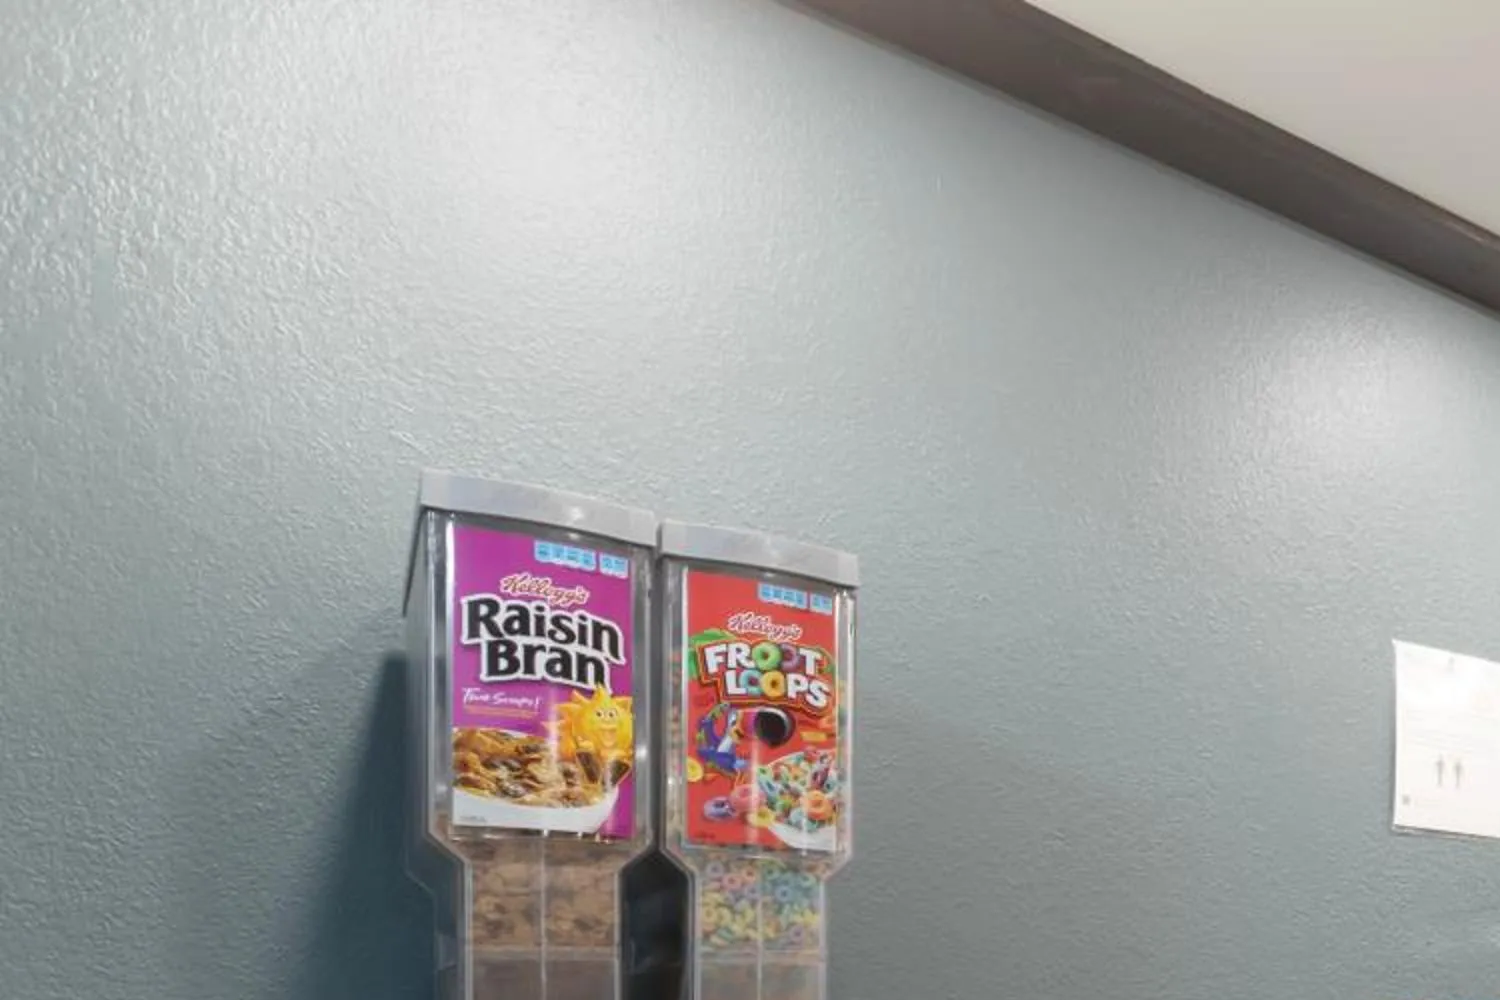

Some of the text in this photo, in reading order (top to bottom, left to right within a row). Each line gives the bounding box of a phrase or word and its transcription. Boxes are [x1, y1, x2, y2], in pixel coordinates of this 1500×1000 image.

[500, 572, 590, 607] Kellogg's
[464, 595, 625, 660] Raisin
[727, 611, 803, 641] Kellogg's
[484, 638, 608, 688] Bran
[704, 641, 822, 676] FROOT
[724, 668, 831, 709] LOOPS
